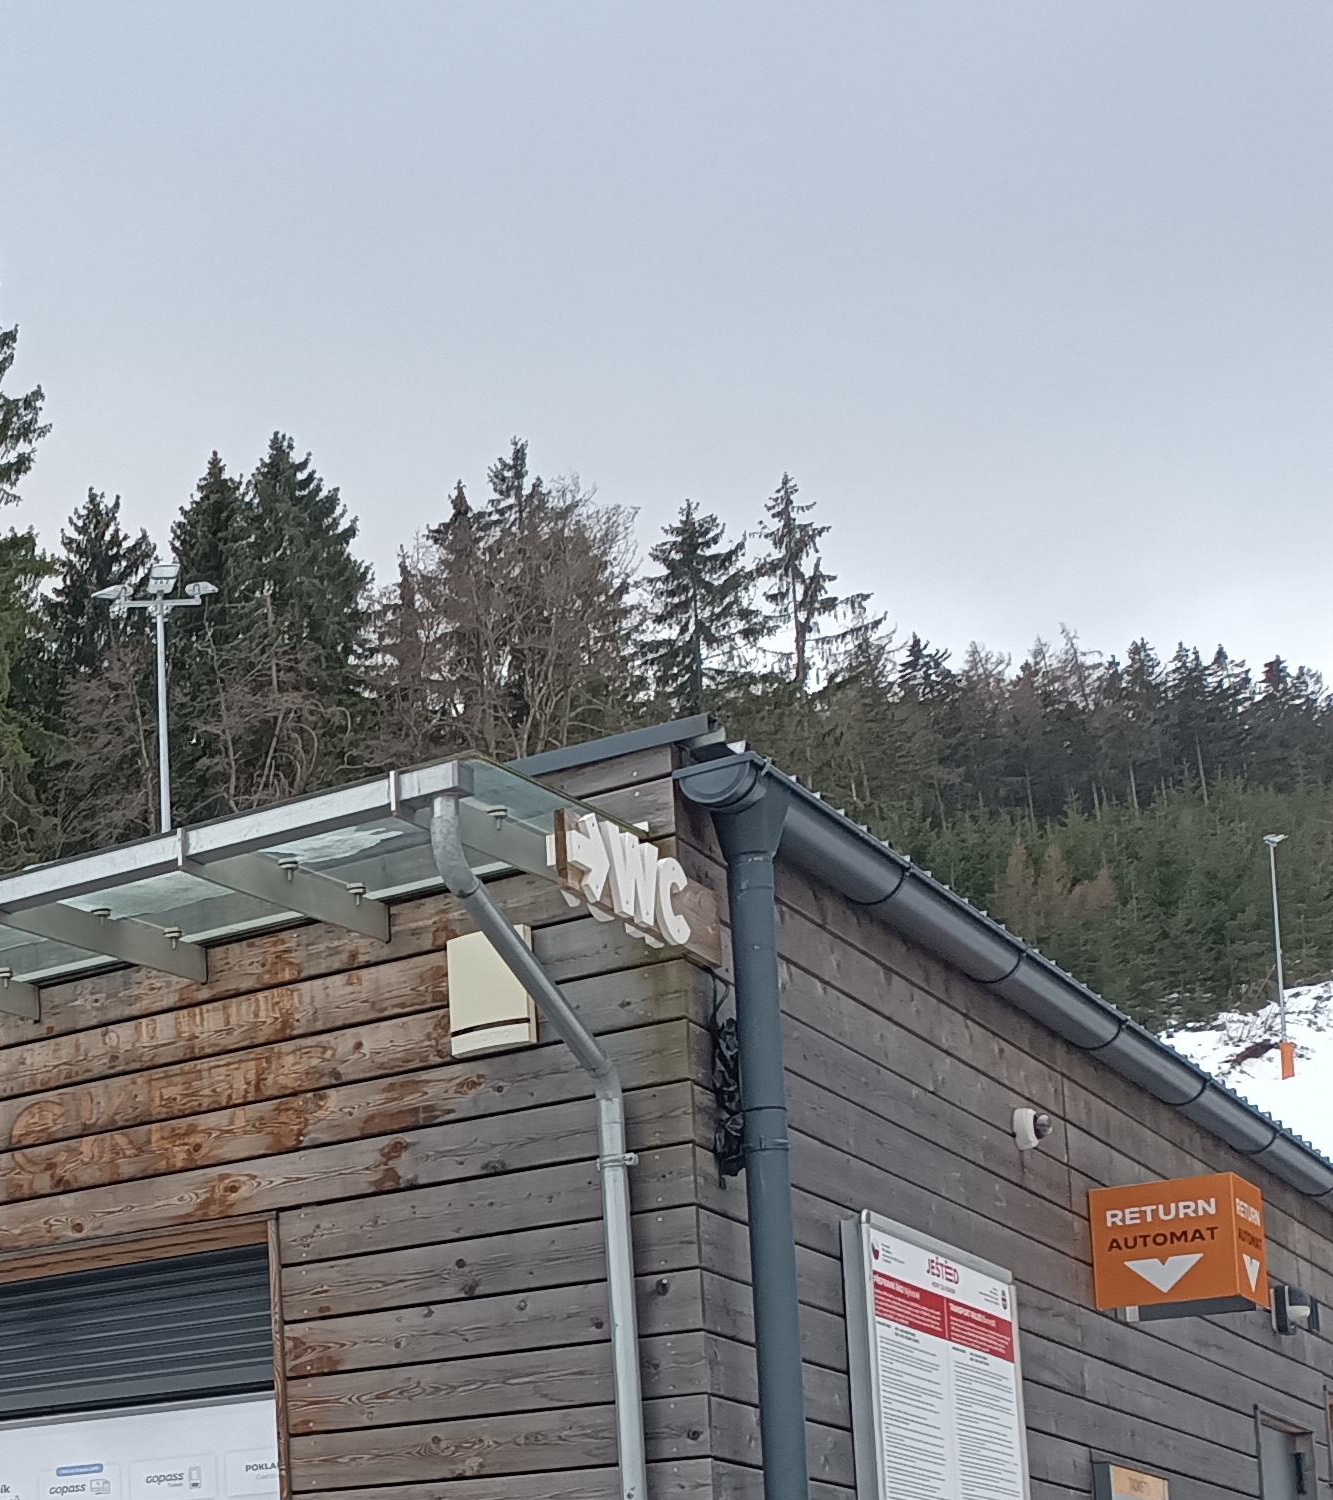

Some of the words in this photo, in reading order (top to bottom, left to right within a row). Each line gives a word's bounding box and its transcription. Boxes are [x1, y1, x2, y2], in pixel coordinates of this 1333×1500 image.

[599, 820, 691, 946] WC
[1106, 1198, 1217, 1228] RETURN
[1235, 1197, 1261, 1227] RETURN
[1107, 1226, 1219, 1251] AUTOMAT
[1237, 1227, 1262, 1251] AUTOMAT
